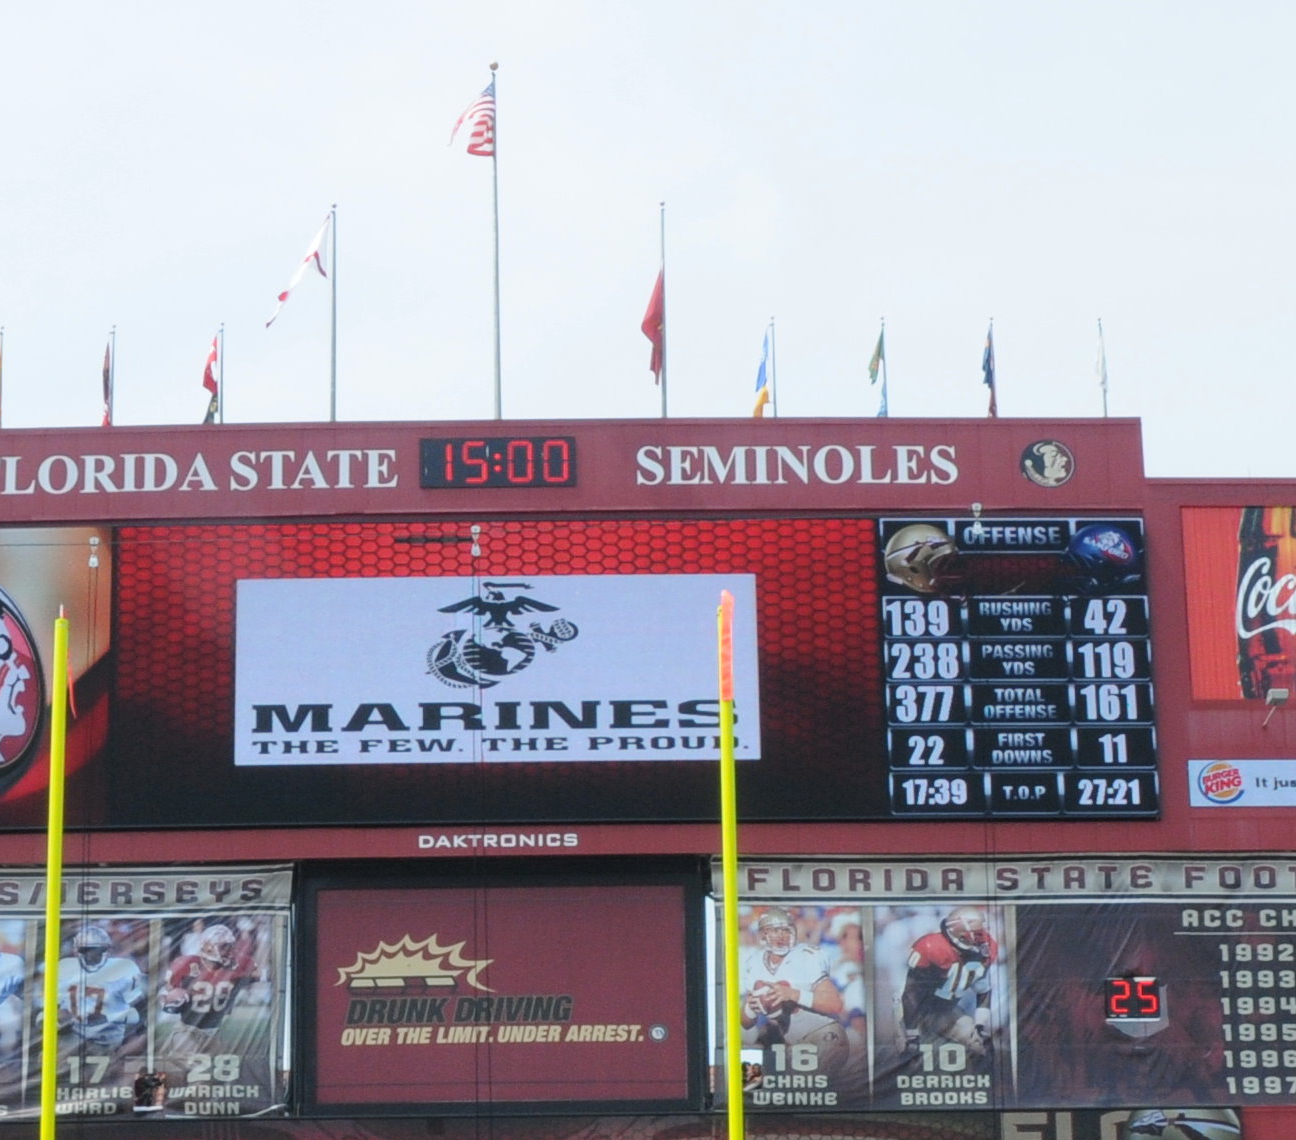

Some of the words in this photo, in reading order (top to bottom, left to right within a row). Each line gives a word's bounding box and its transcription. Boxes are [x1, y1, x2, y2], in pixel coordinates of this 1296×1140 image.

[230, 448, 399, 492] STATE
[442, 439, 569, 484] 15:00
[636, 444, 959, 487] SEMINOLES
[963, 525, 1061, 547] OFFENSE
[886, 599, 949, 637] 139
[979, 601, 1052, 616] RUSHING
[1083, 598, 1128, 636] 42
[1000, 617, 1033, 632] YDS
[890, 641, 960, 679] 238
[981, 644, 1054, 660] PASSING
[1078, 641, 1136, 679] 119
[1002, 660, 1036, 676] YDS
[895, 684, 955, 723] 377
[993, 688, 1046, 702] TOTAL
[1080, 683, 1139, 721] 161
[251, 698, 739, 734] MARINES
[983, 704, 1058, 720] OFFENSE
[252, 740, 340, 755] THE
[358, 738, 464, 753] FEW.
[482, 737, 569, 752] THE
[908, 734, 945, 766] 22
[997, 732, 1046, 747] FIRST
[1098, 732, 1128, 764] 11
[991, 749, 1054, 765] DOWNS
[902, 778, 969, 806] 17:39
[1077, 777, 1142, 806] 27:21
[1204, 775, 1243, 796] KING
[1255, 776, 1268, 789] It
[417, 832, 579, 850] DAKTRONICS
[746, 865, 966, 894] FLORIDA
[996, 864, 1153, 892] STATE
[1181, 908, 1244, 929] ACC
[1218, 942, 1295, 963] 1992
[1219, 969, 1296, 990] 1993
[1108, 980, 1160, 1015] 25
[346, 996, 449, 1026] DRUNK
[453, 995, 574, 1023] DRIVING
[341, 1027, 391, 1047] OVER
[396, 1026, 433, 1045] THE
[436, 1025, 495, 1044] LIMIT.
[497, 1025, 562, 1043] UNDER
[565, 1024, 645, 1043] ARREST.
[186, 1053, 240, 1082] 28
[772, 1042, 819, 1072] 16
[919, 1042, 967, 1072] 10
[67, 1055, 111, 1083] 17
[168, 1085, 260, 1099] WARRICK
[763, 1074, 828, 1089] CHRIS
[896, 1074, 991, 1089] DERRICK
[55, 1086, 133, 1100] HARLIE
[752, 1091, 838, 1106] WEINKE
[901, 1091, 988, 1105] BROOKS
[184, 1100, 240, 1115] DUNN
